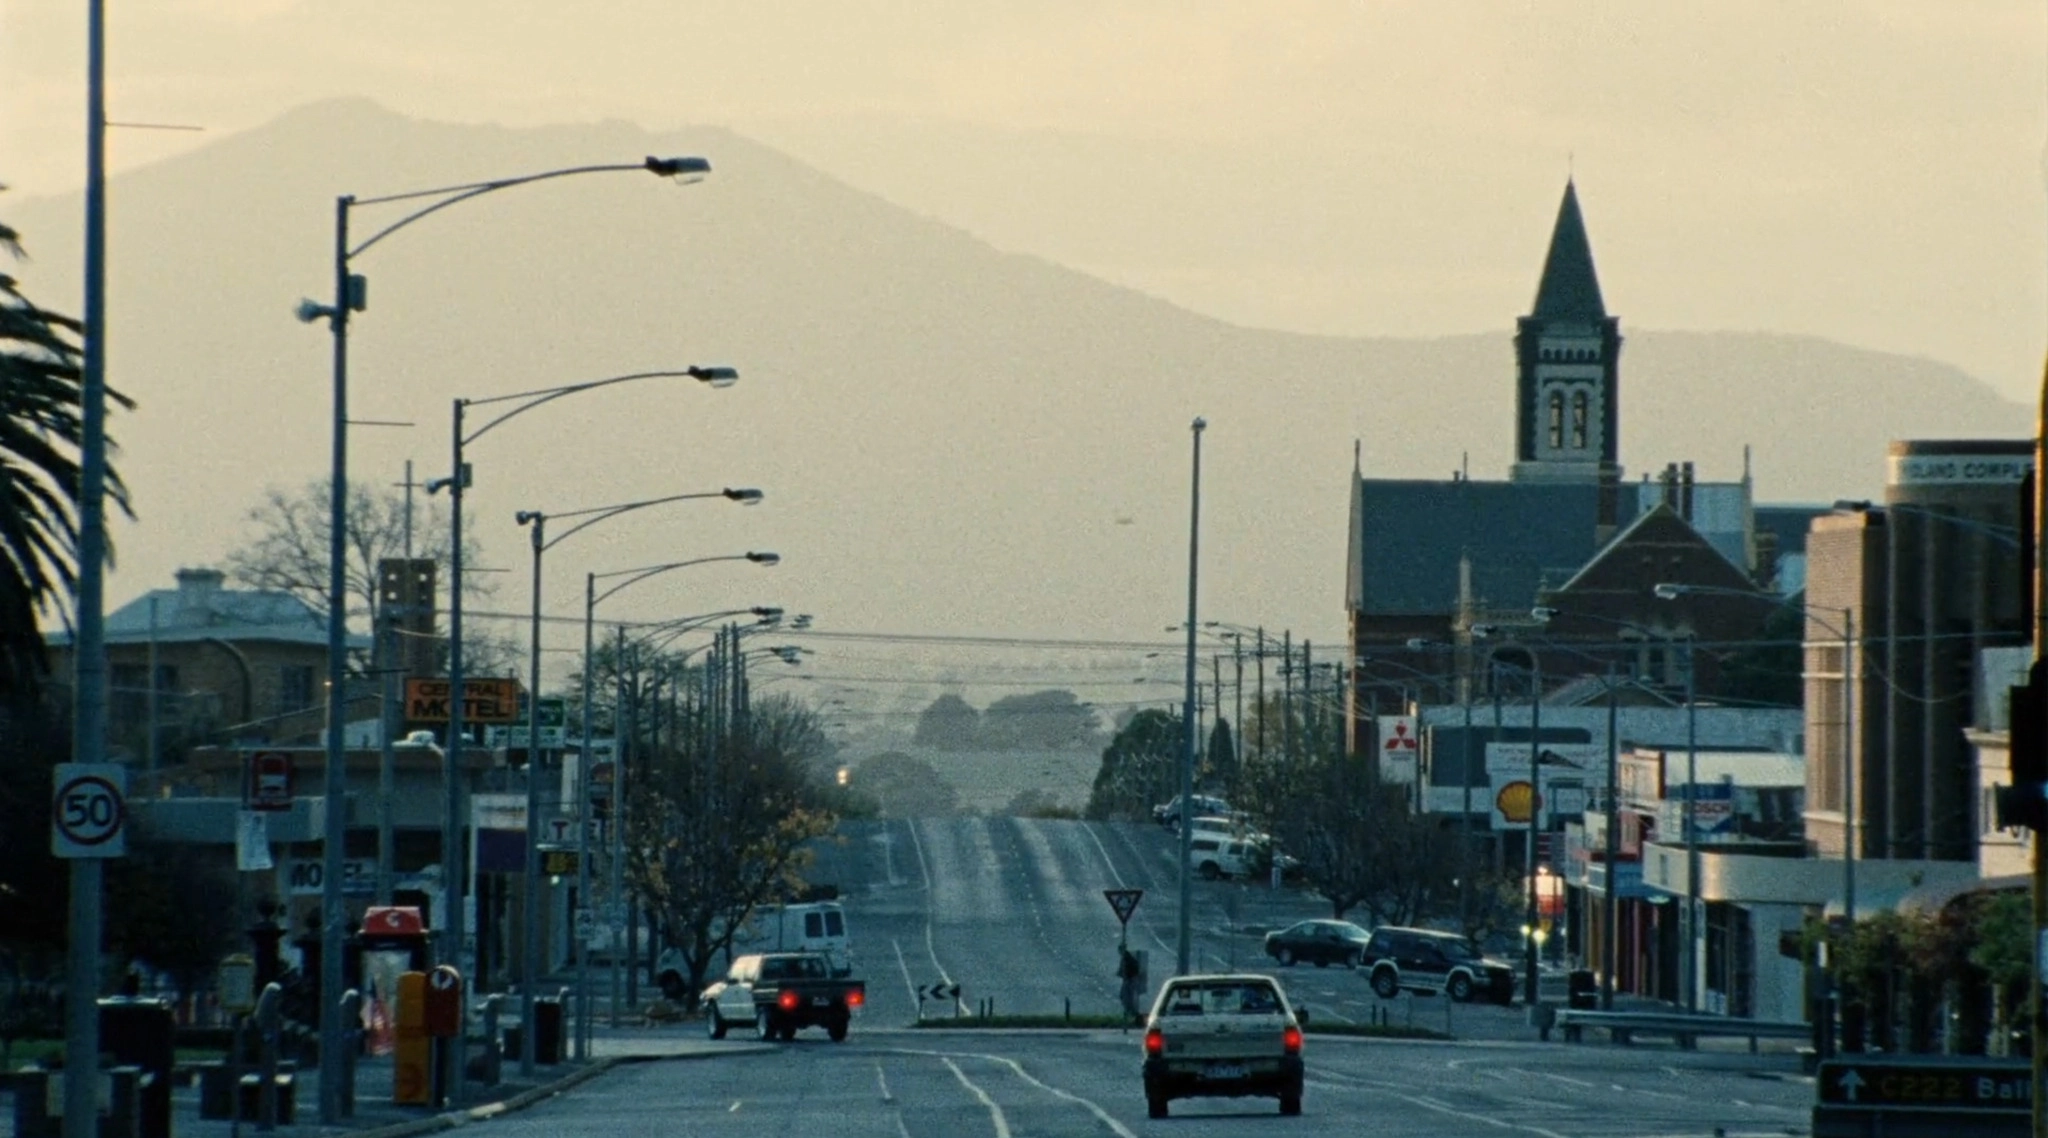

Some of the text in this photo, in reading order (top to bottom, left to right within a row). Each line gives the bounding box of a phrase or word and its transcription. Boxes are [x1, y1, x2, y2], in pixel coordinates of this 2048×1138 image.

[418, 683, 504, 696] CERAL
[66, 795, 111, 826] 50
[1880, 1076, 1963, 1099] C222
